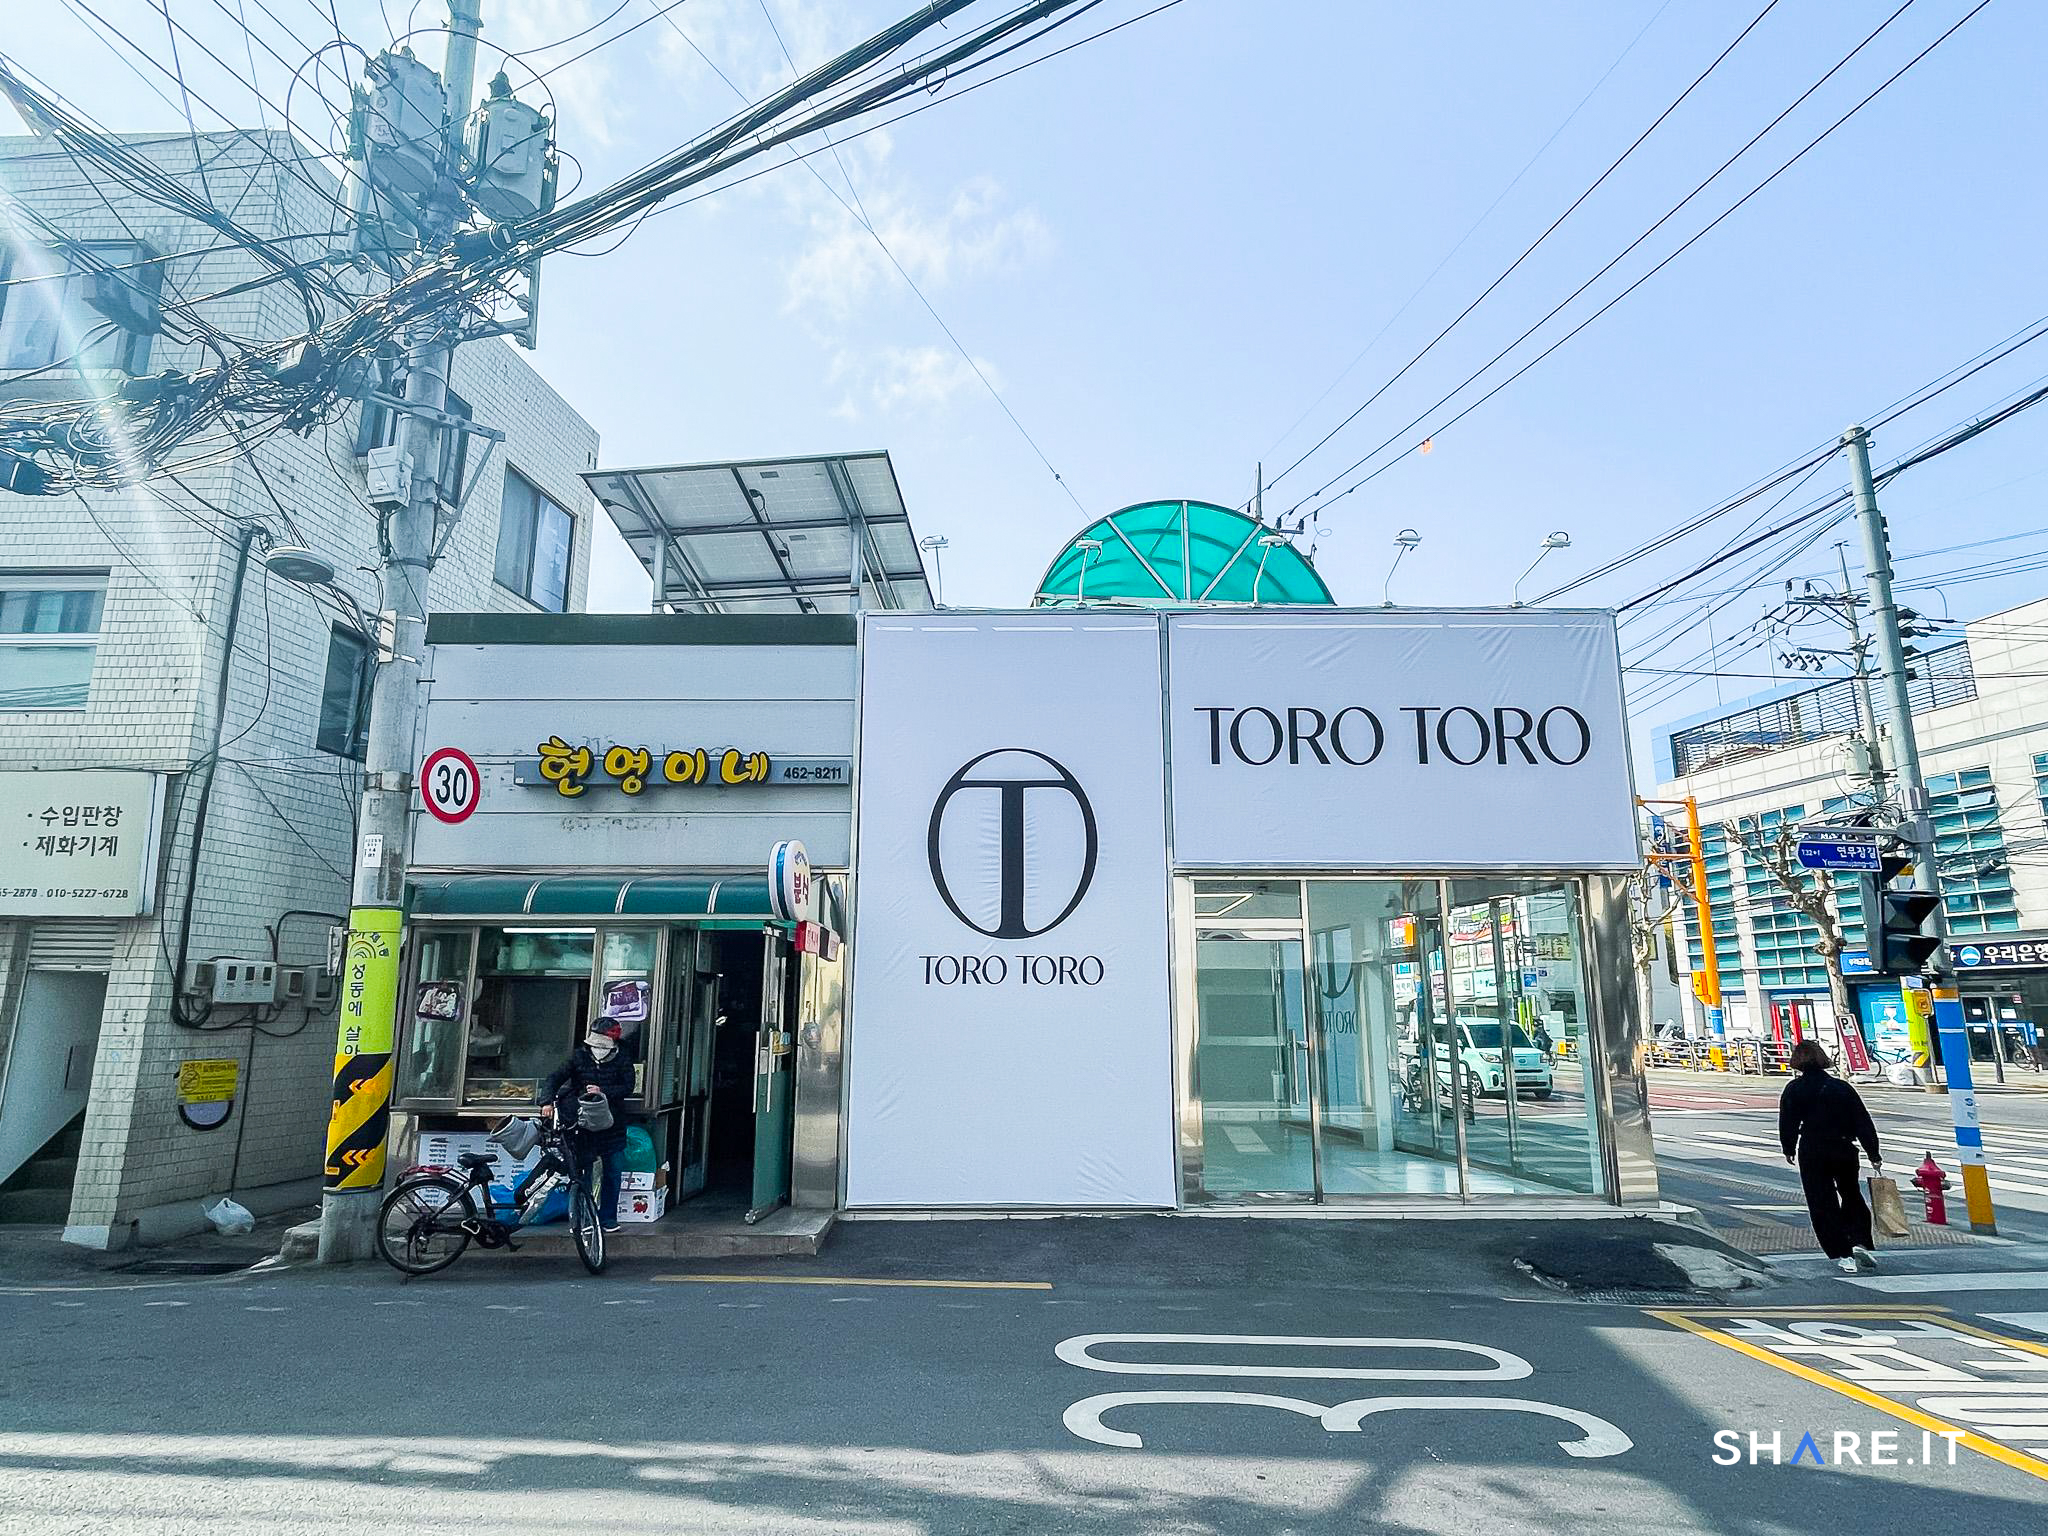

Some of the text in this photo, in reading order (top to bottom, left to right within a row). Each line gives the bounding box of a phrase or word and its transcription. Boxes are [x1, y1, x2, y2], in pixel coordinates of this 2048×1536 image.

[1194, 706, 1591, 766] TORO TORO
[537, 735, 772, 798] 현영이네
[783, 766, 842, 782] 462-8211
[436, 764, 468, 808] 30
[40, 805, 123, 827] 수입판창
[34, 835, 119, 857] 제화기계
[1836, 846, 1877, 860] 연무장길
[0, 888, 129, 899] 5-2878 010-5227-6728
[918, 955, 1105, 986] TORO TORO
[348, 963, 366, 1017] 성동에
[1055, 1333, 1633, 1459] 30
